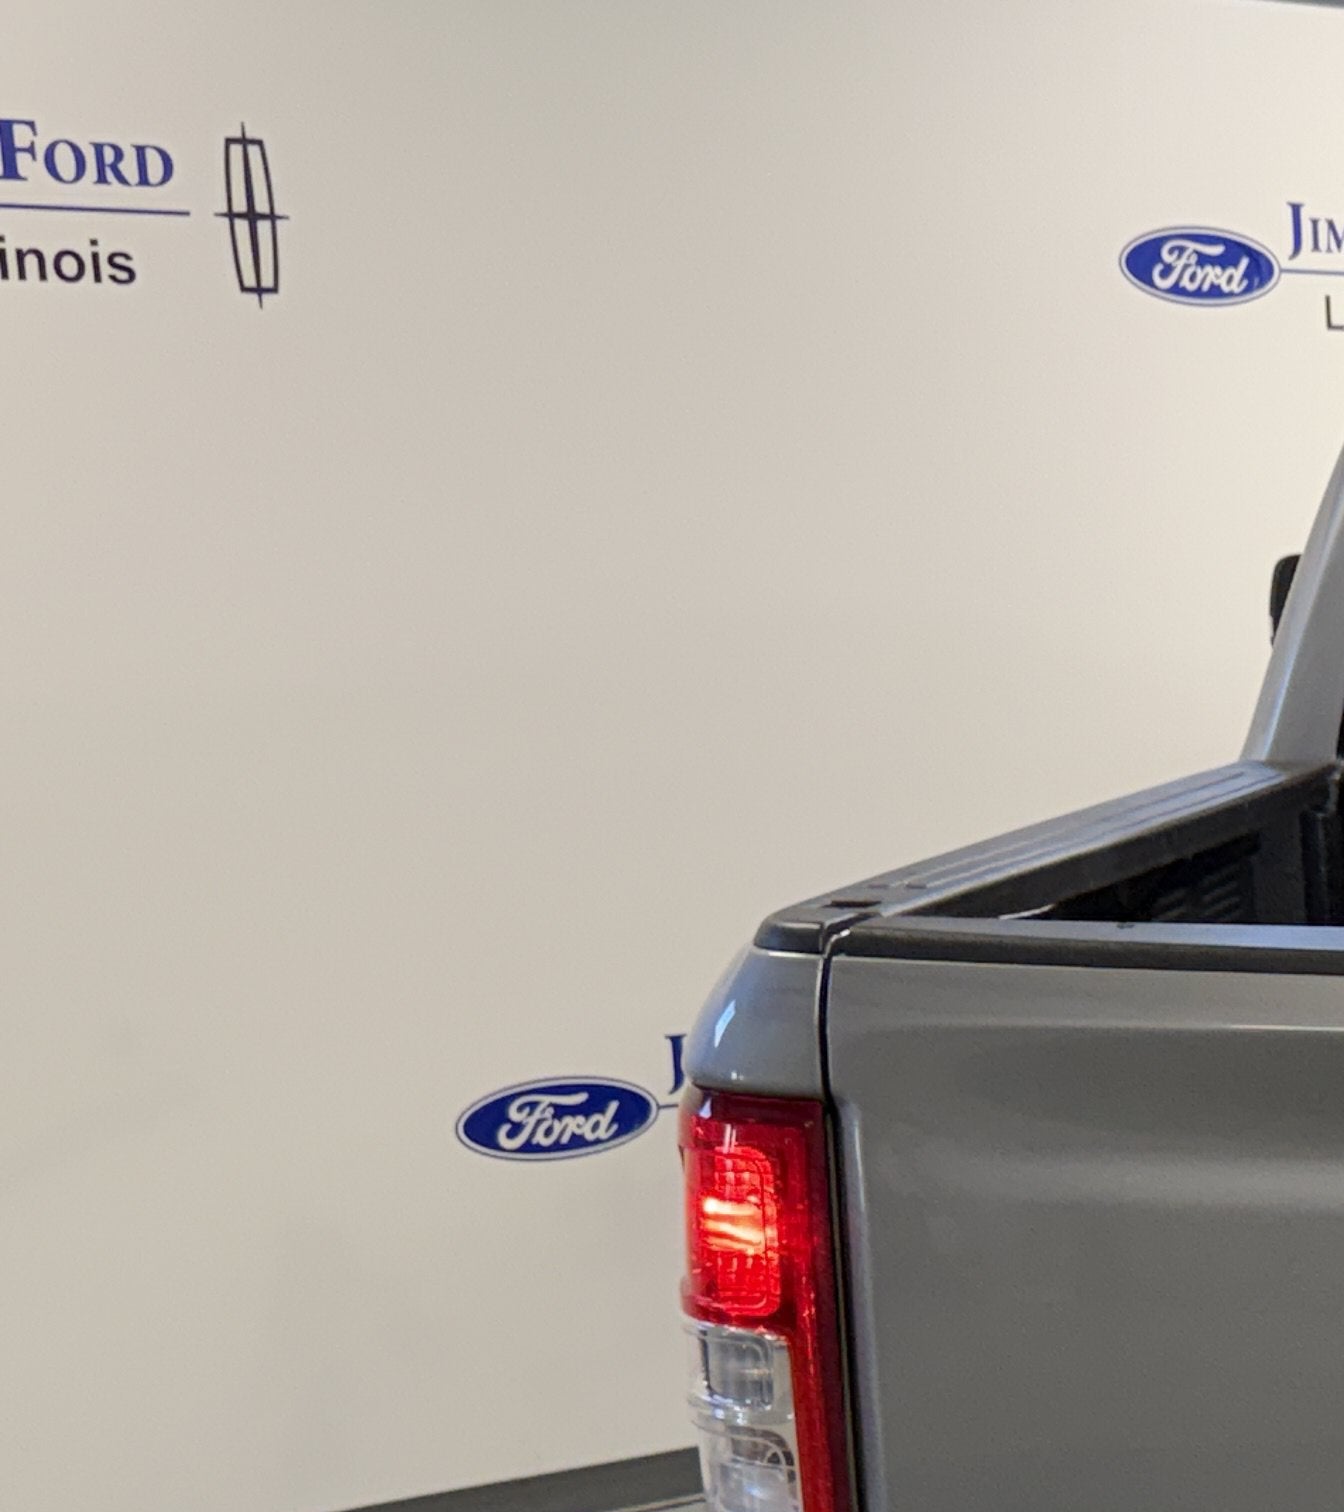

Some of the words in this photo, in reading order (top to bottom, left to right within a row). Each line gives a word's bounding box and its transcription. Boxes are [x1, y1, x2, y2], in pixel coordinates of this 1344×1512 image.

[0, 118, 174, 188] FORD
[0, 235, 137, 285] inois
[1152, 238, 1250, 293] Ford
[497, 1092, 620, 1151] Ford
